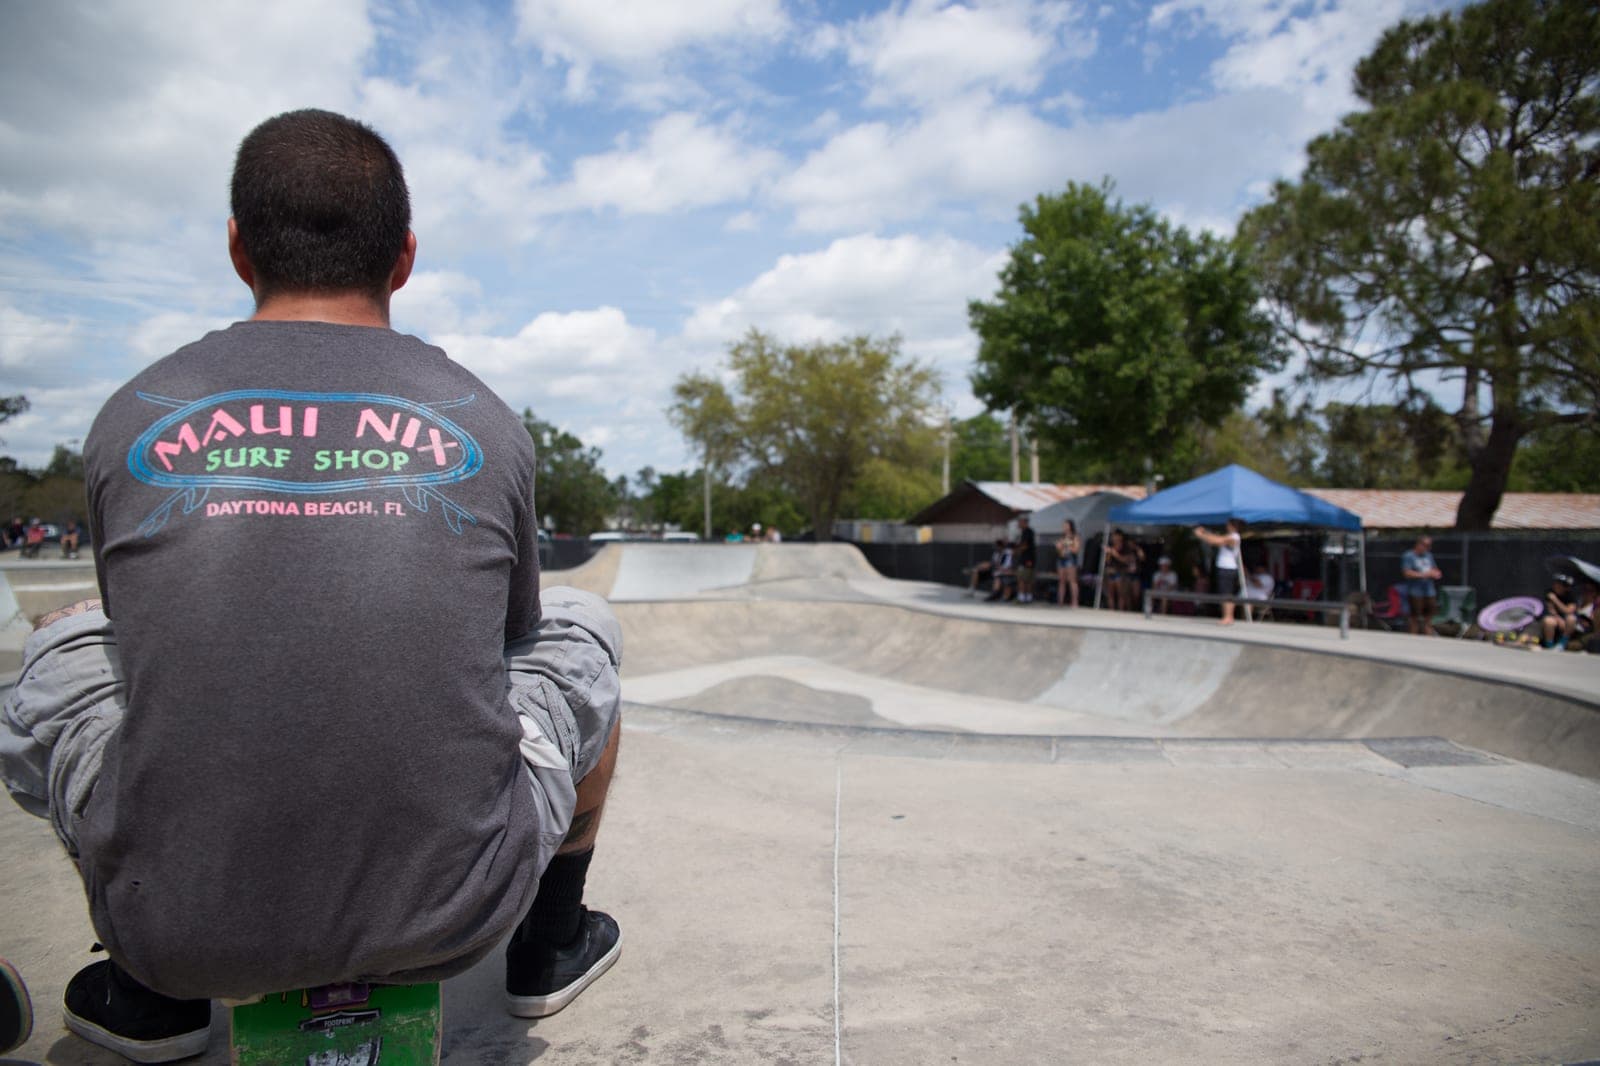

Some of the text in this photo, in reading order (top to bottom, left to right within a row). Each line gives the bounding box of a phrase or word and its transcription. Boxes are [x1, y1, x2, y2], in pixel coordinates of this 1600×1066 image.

[154, 405, 458, 471] MAUI NIX
[206, 447, 409, 471] SURF SHOP
[206, 501, 406, 517] DAYTONA BEACH, FL
